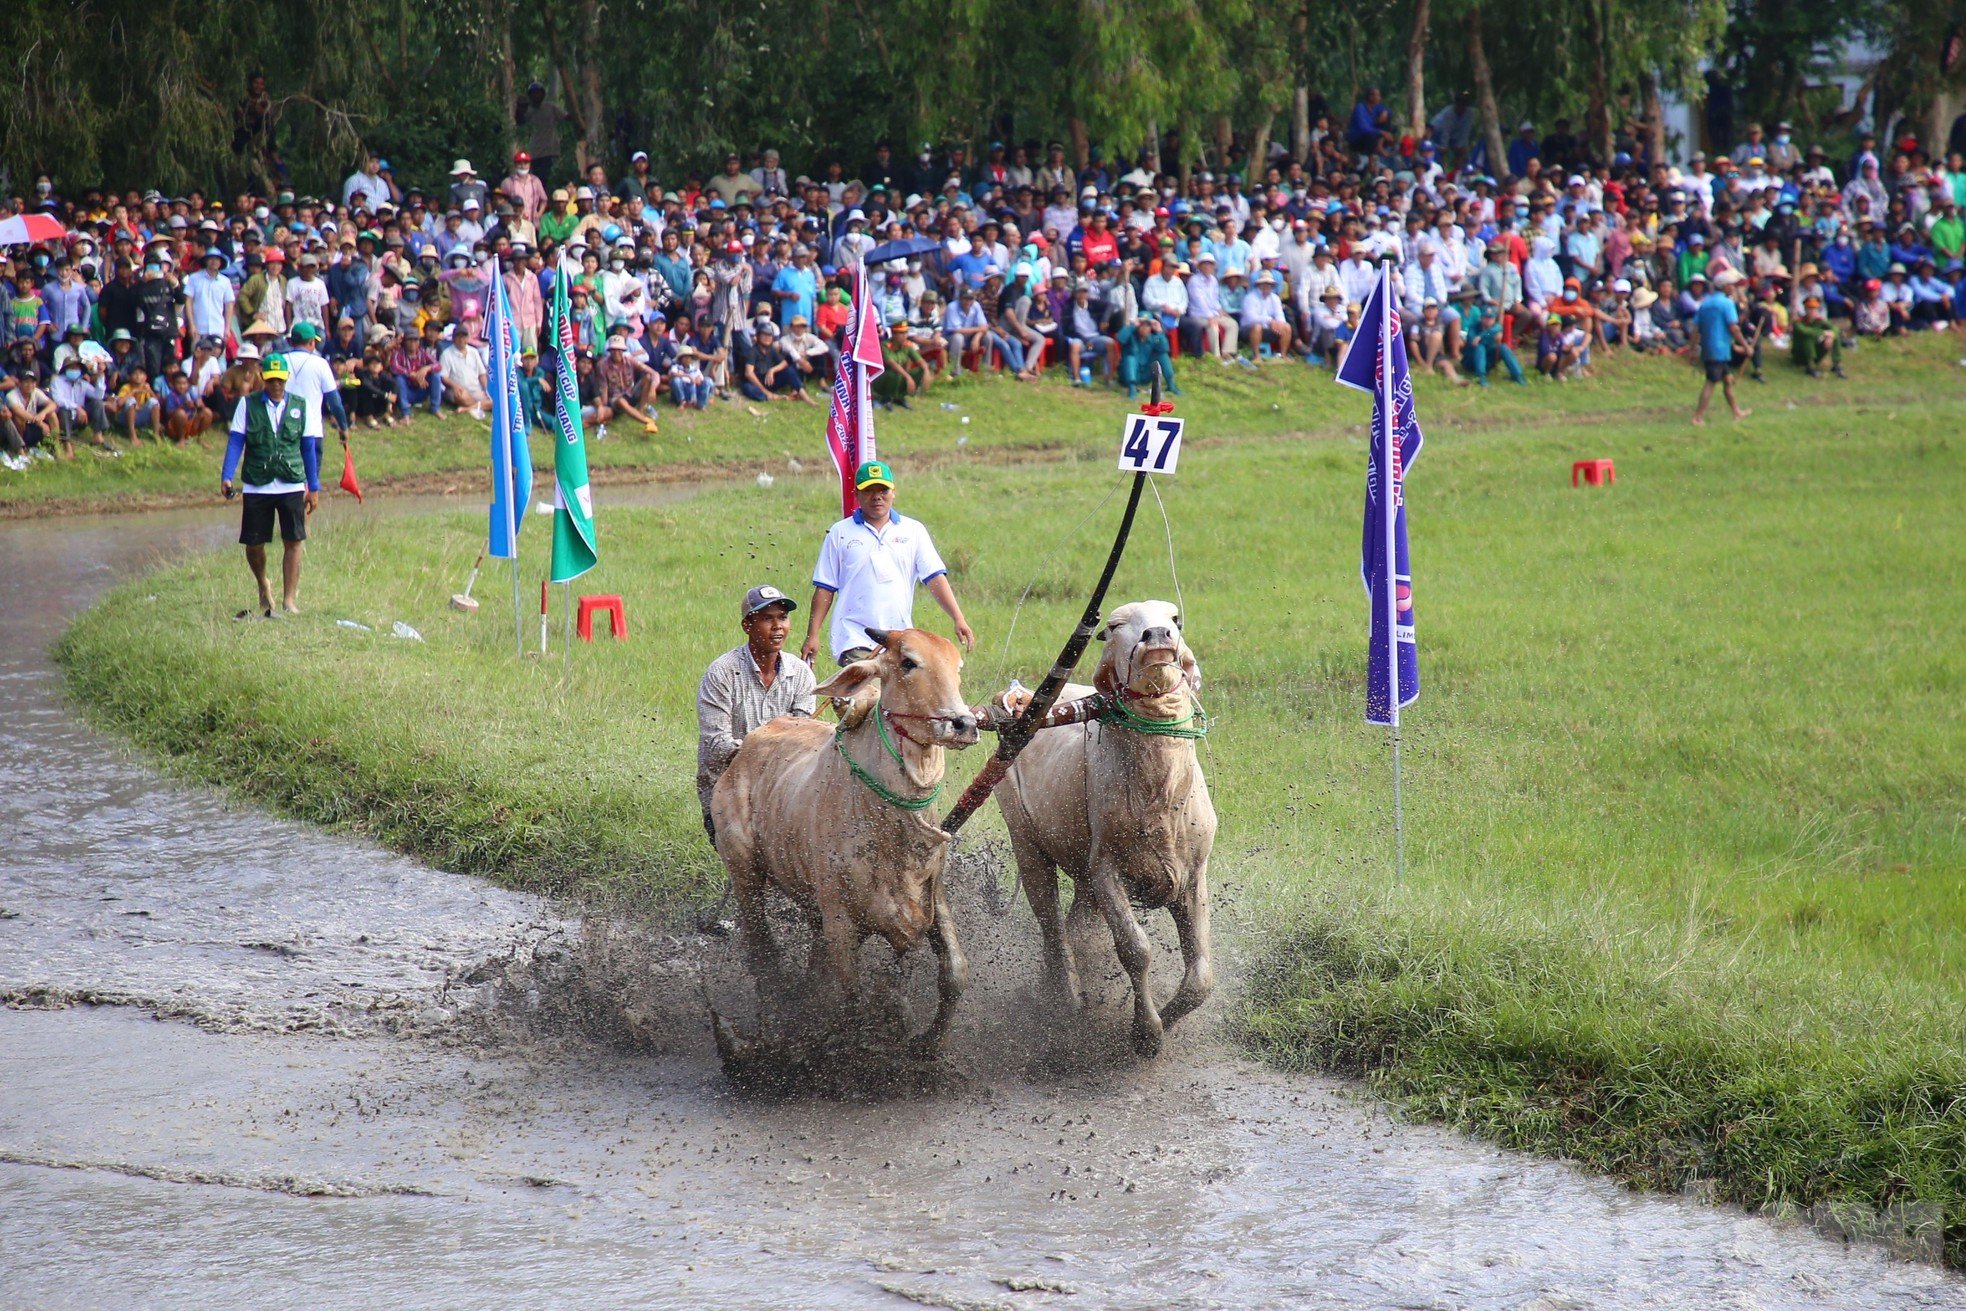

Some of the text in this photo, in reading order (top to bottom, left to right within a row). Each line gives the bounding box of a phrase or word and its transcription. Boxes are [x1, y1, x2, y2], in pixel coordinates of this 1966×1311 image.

[557, 405, 577, 442] GIANG
[1124, 419, 1180, 469] 47
[1396, 631, 1414, 640] LIM
